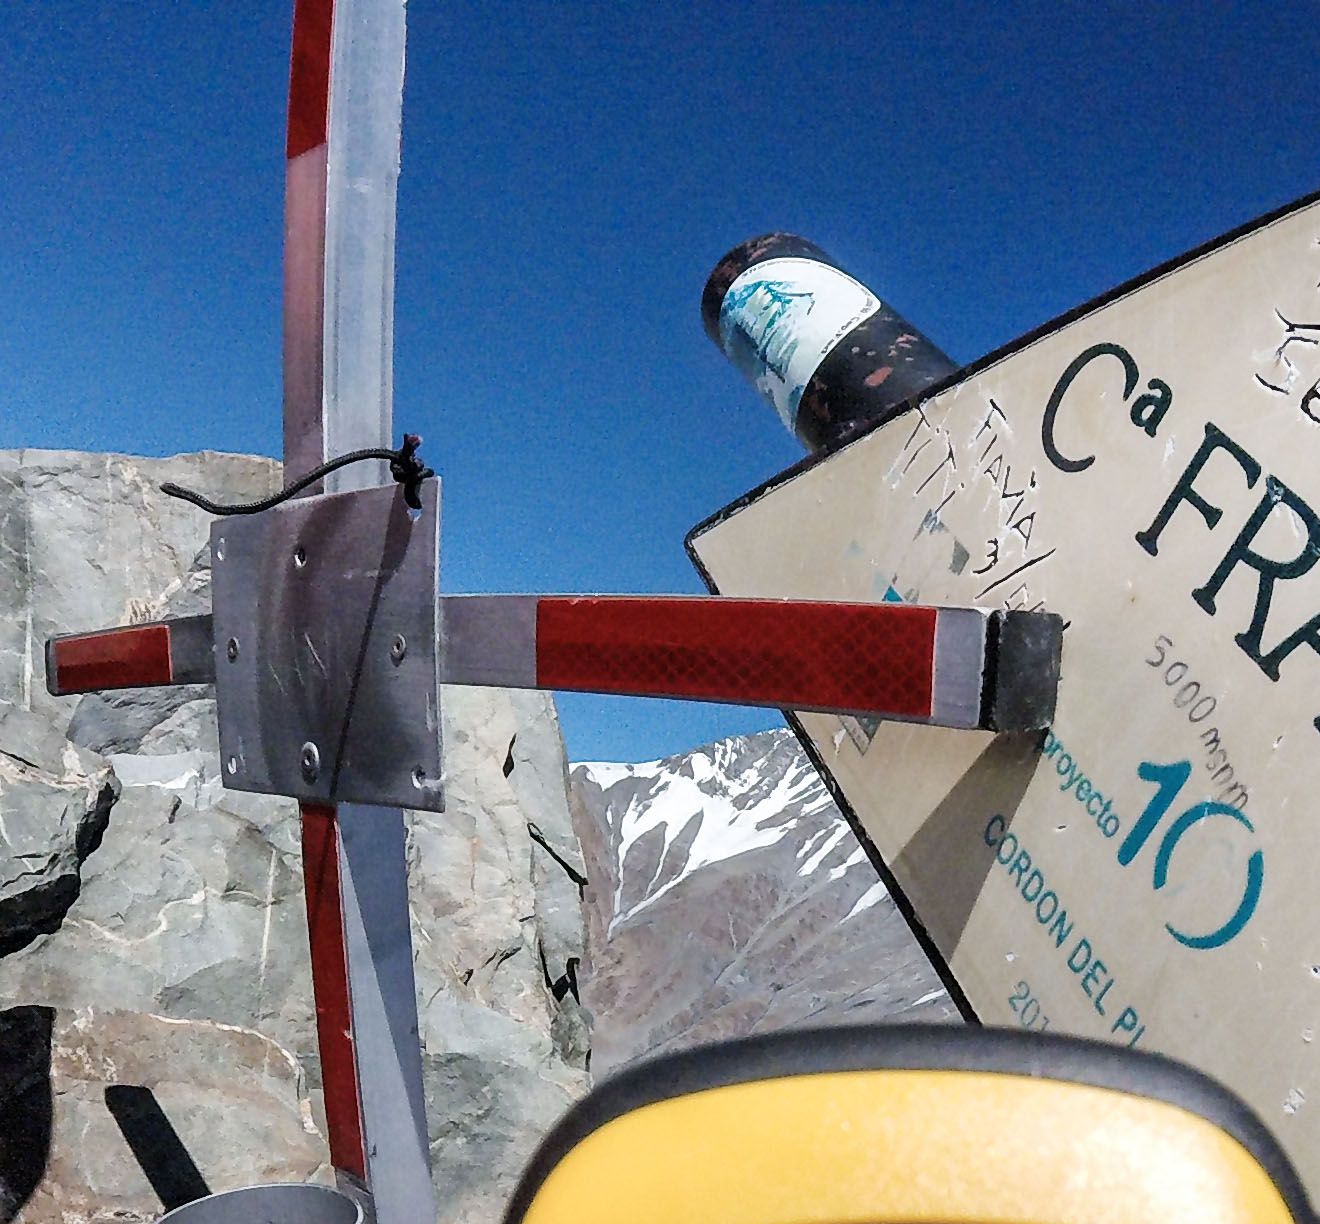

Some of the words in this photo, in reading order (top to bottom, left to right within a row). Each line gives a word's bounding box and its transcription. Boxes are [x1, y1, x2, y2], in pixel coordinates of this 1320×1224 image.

[1144, 634, 1218, 724] 5000
[984, 813, 1075, 949] CORDON
[1067, 936, 1115, 1017] DEL
[1038, 730, 1121, 839] proyecto
[1117, 759, 1265, 950] 10
